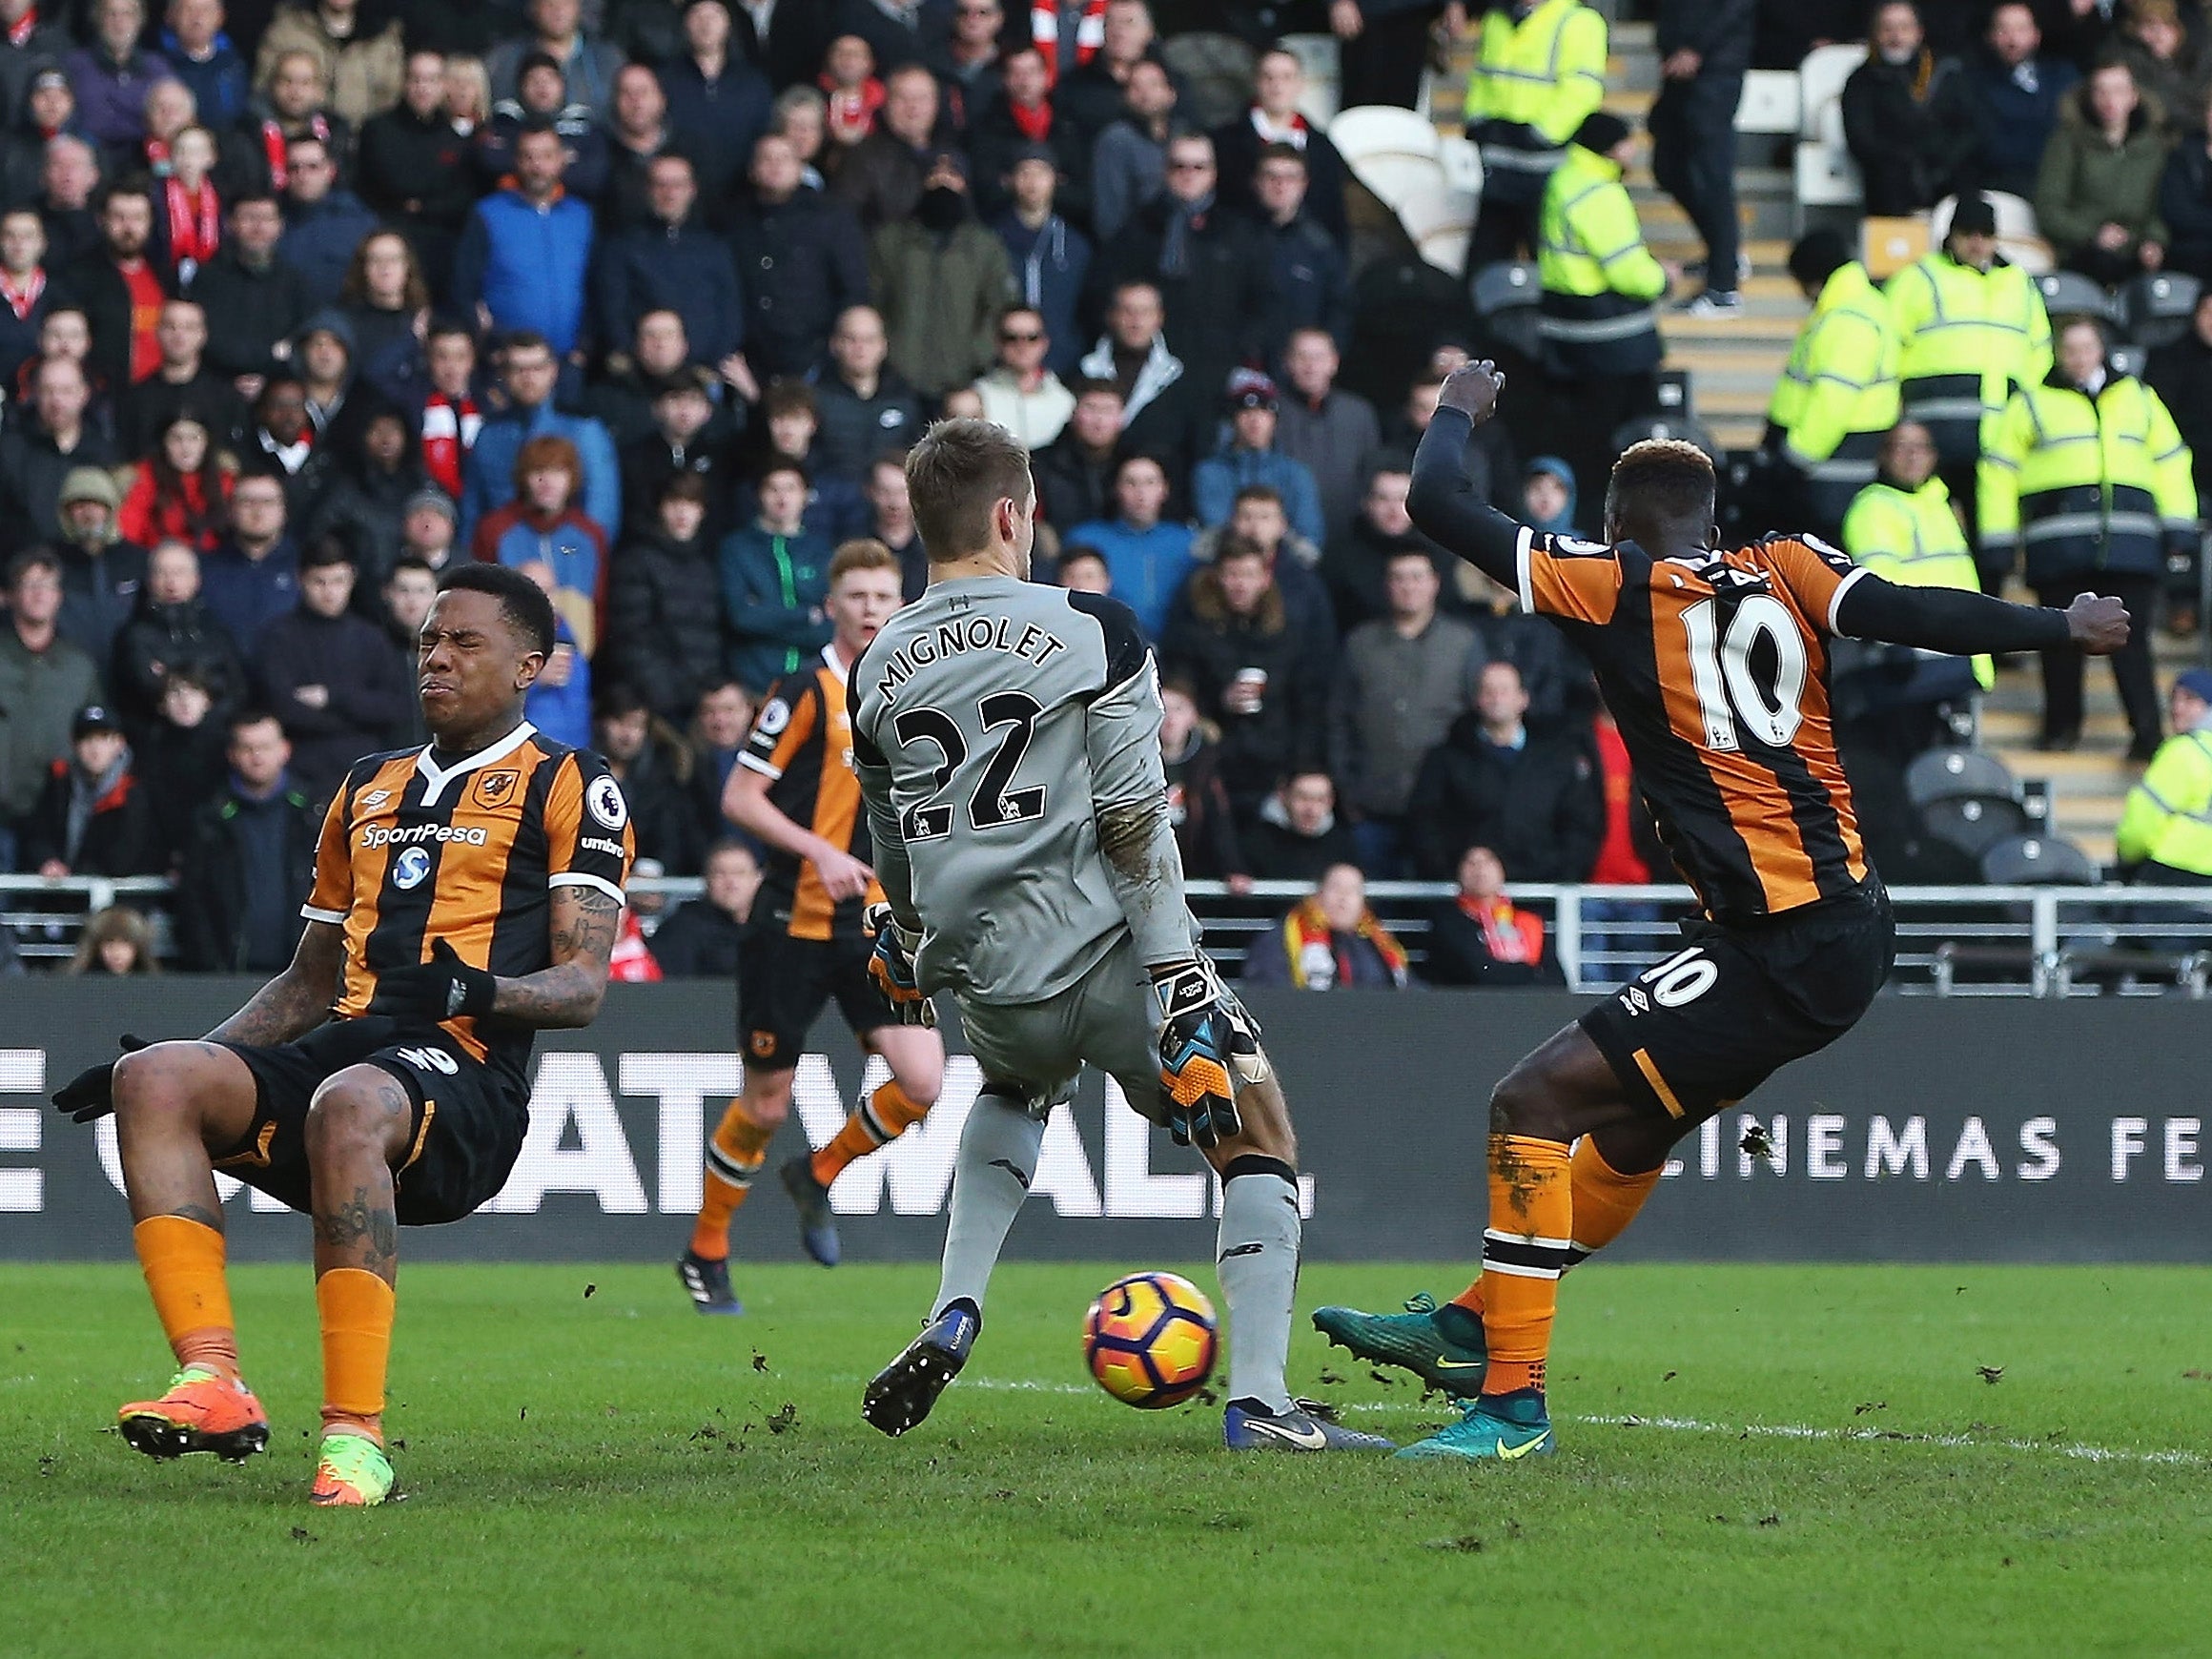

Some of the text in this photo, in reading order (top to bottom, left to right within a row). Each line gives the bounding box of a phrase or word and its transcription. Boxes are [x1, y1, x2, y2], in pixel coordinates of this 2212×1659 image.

[877, 616, 1066, 705] MIGNOLET
[1679, 594, 1807, 750] 10
[892, 689, 1047, 842] 22
[361, 824, 487, 849] SportPesa
[582, 837, 625, 858] umbro
[1641, 947, 1717, 1007] 10
[1660, 1114, 2204, 1181] INEMAS FE
